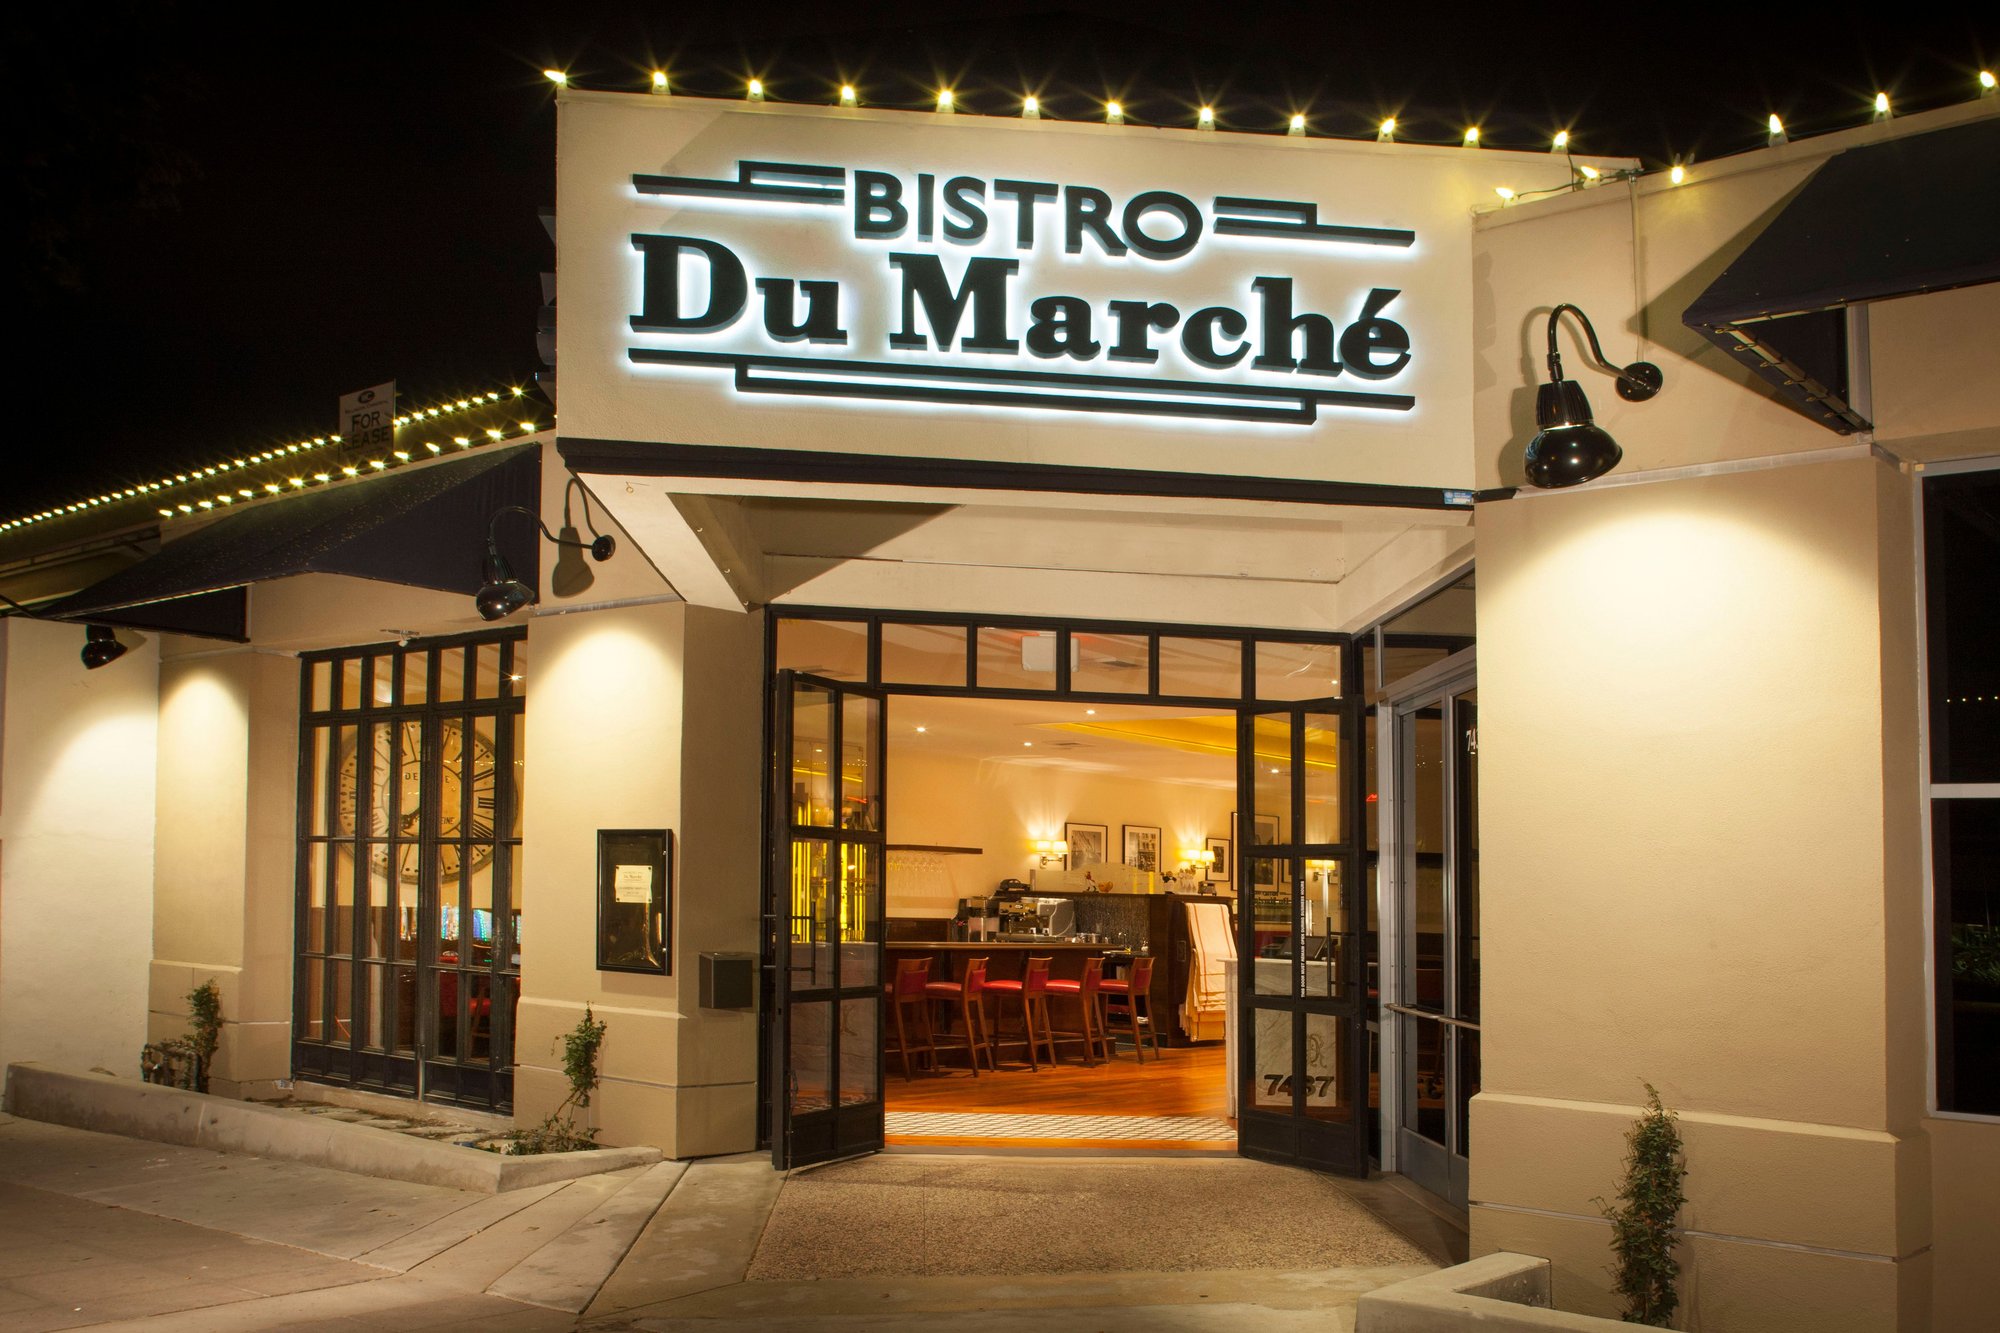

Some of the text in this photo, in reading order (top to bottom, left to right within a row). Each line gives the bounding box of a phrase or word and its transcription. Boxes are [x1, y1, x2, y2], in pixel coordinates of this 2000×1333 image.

[854, 169, 1204, 261] BISTRO
[629, 232, 1412, 381] Du Marché
[351, 410, 381, 432] FOR
